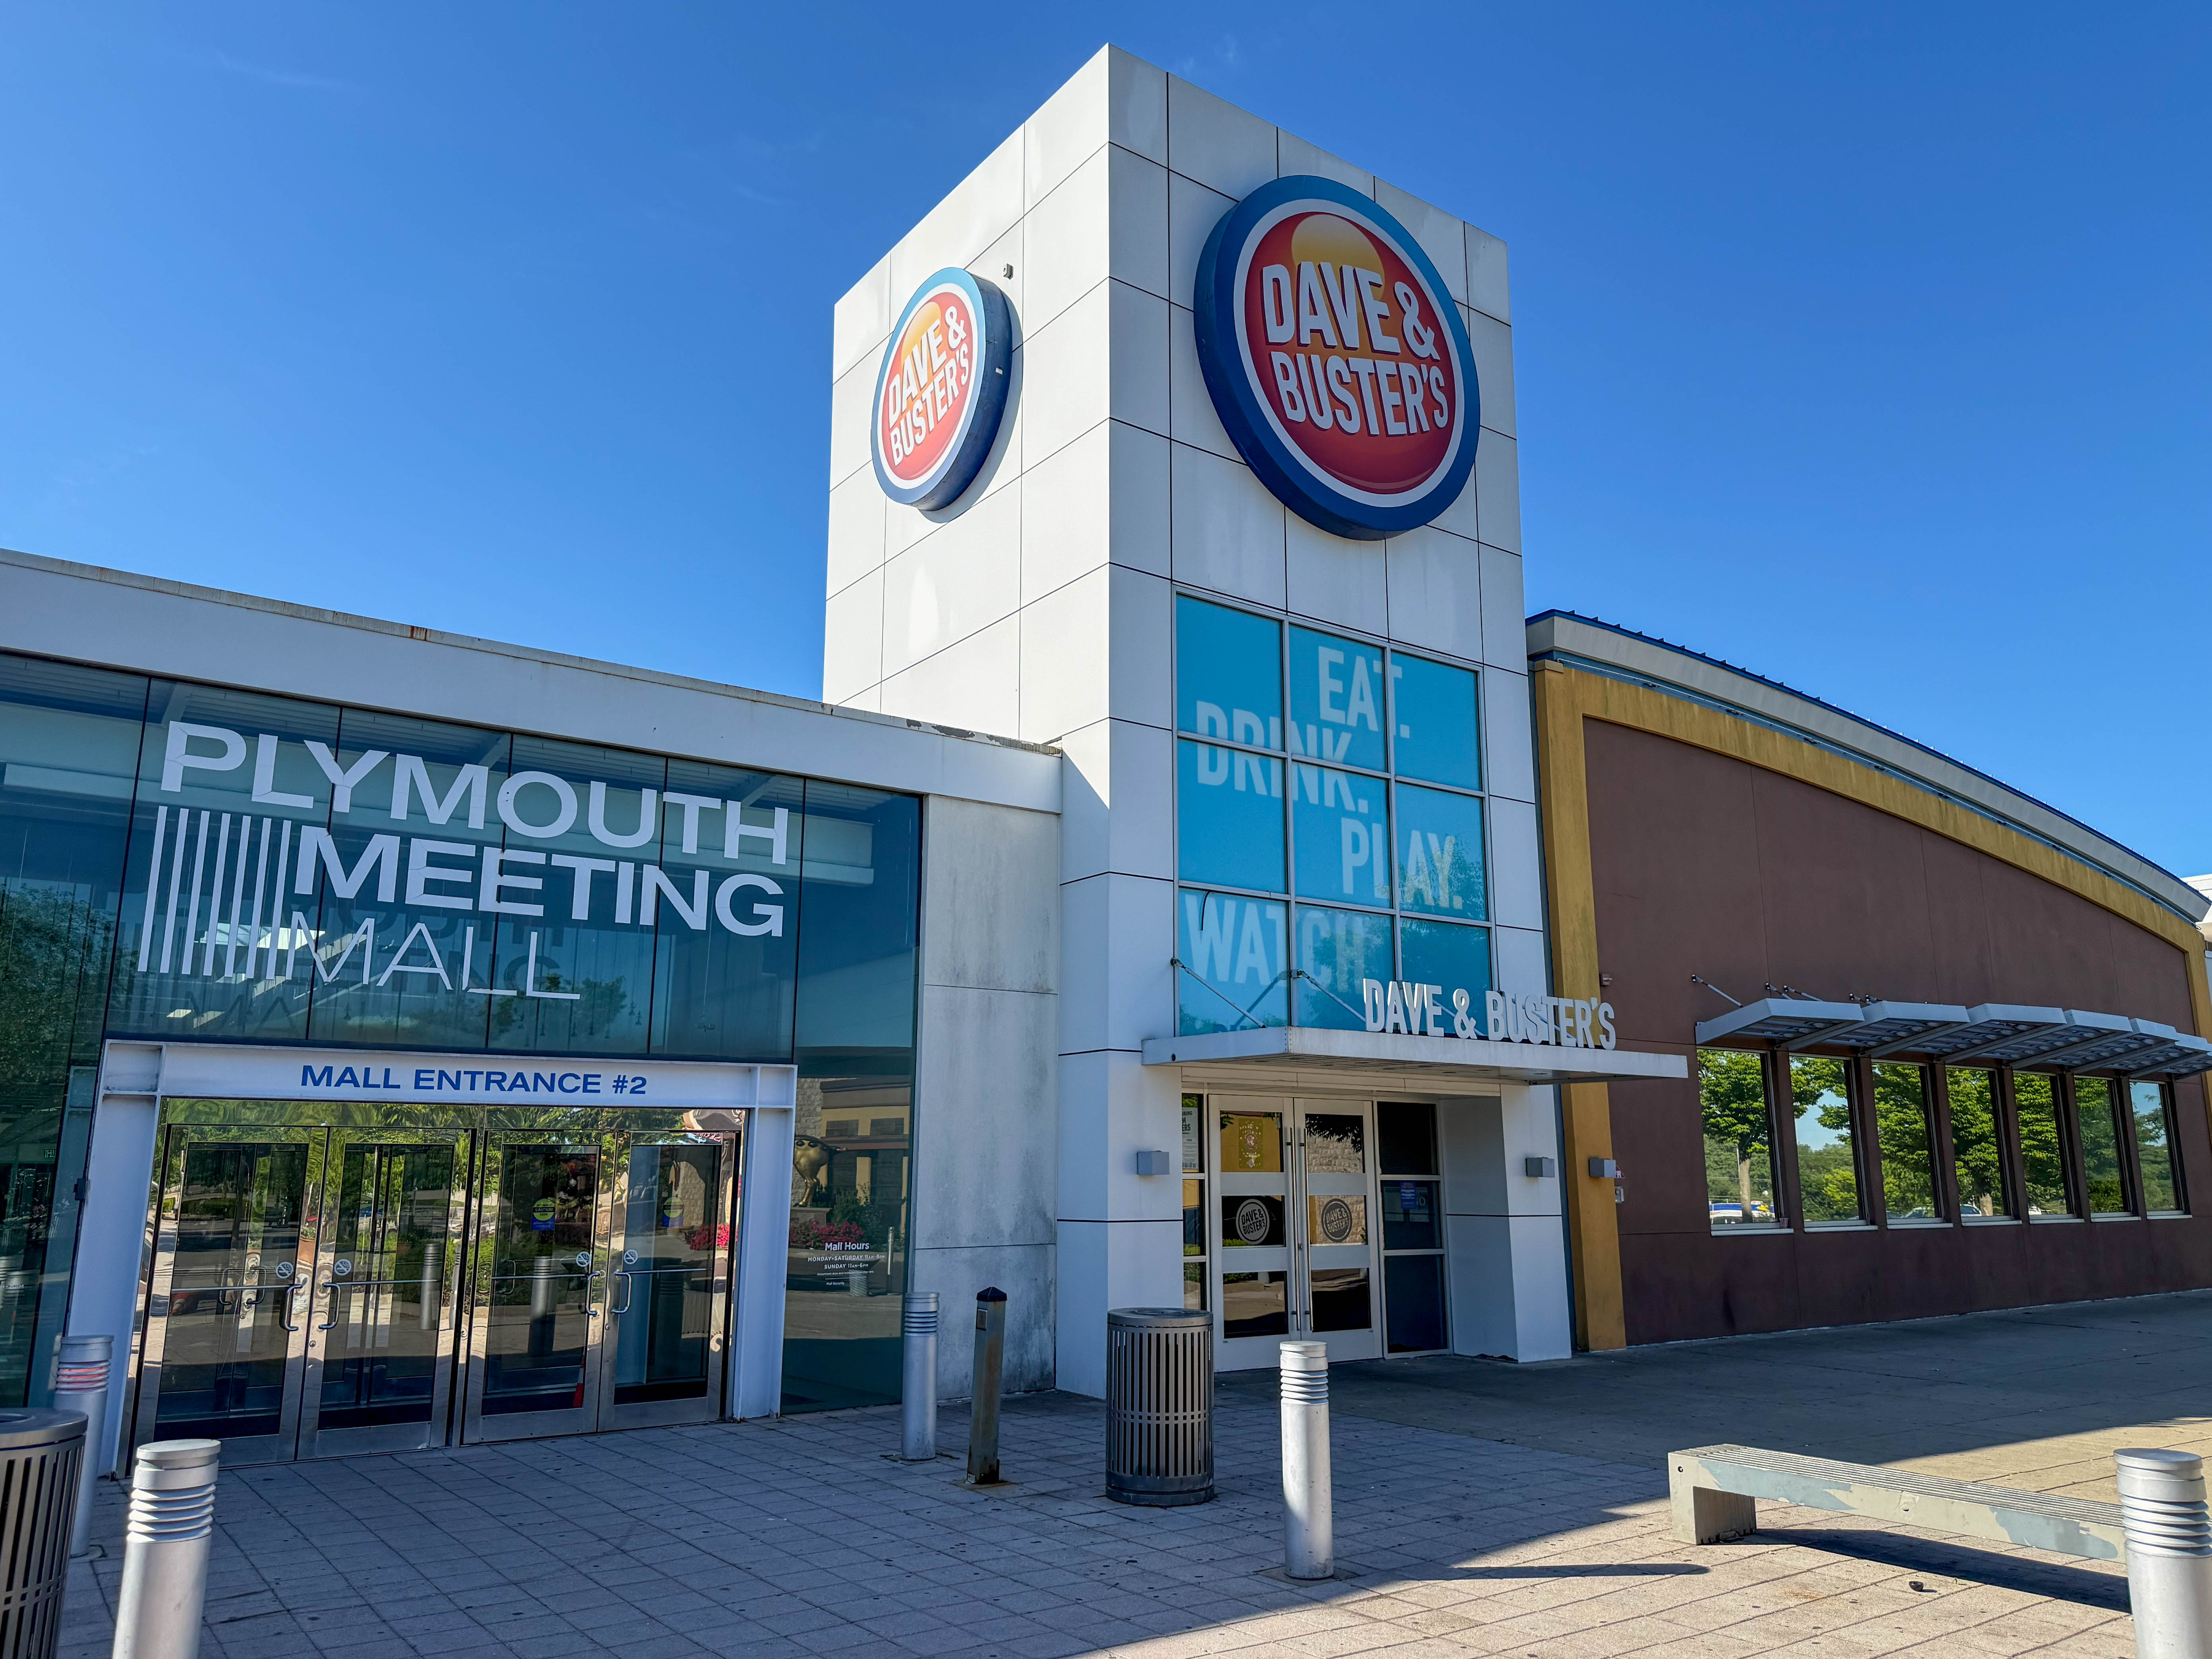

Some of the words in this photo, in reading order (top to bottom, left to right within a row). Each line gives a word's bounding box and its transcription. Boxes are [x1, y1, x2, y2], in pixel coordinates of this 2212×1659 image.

[1262, 261, 1400, 355] DAVE
[1393, 281, 1441, 361] &
[889, 318, 947, 430] DAVE
[945, 306, 967, 349] &
[890, 343, 969, 466] BUSTER'S
[1270, 350, 1449, 438] BUSTER'S
[1318, 646, 1410, 739] EAT.
[161, 721, 788, 865] PLYMOUTH
[1196, 700, 1368, 814] DRINK.
[294, 825, 784, 937] MEETING
[1340, 817, 1463, 910] PLAY.
[285, 911, 581, 1000] MALL
[1363, 978, 1444, 1037] DAVE
[1453, 988, 1477, 1039] &
[1485, 990, 1616, 1050] BUSTER'S
[301, 1065, 401, 1089] MALL
[414, 1069, 601, 1094] ENTRANCE
[613, 1076, 647, 1095] #2
[825, 1242, 842, 1251] Mall
[845, 1242, 870, 1250] Hours
[1241, 1209, 1259, 1225] DAVE
[1258, 1209, 1264, 1218] &
[1243, 1218, 1265, 1234] BUSTER'S
[1327, 1208, 1342, 1223] DAVE
